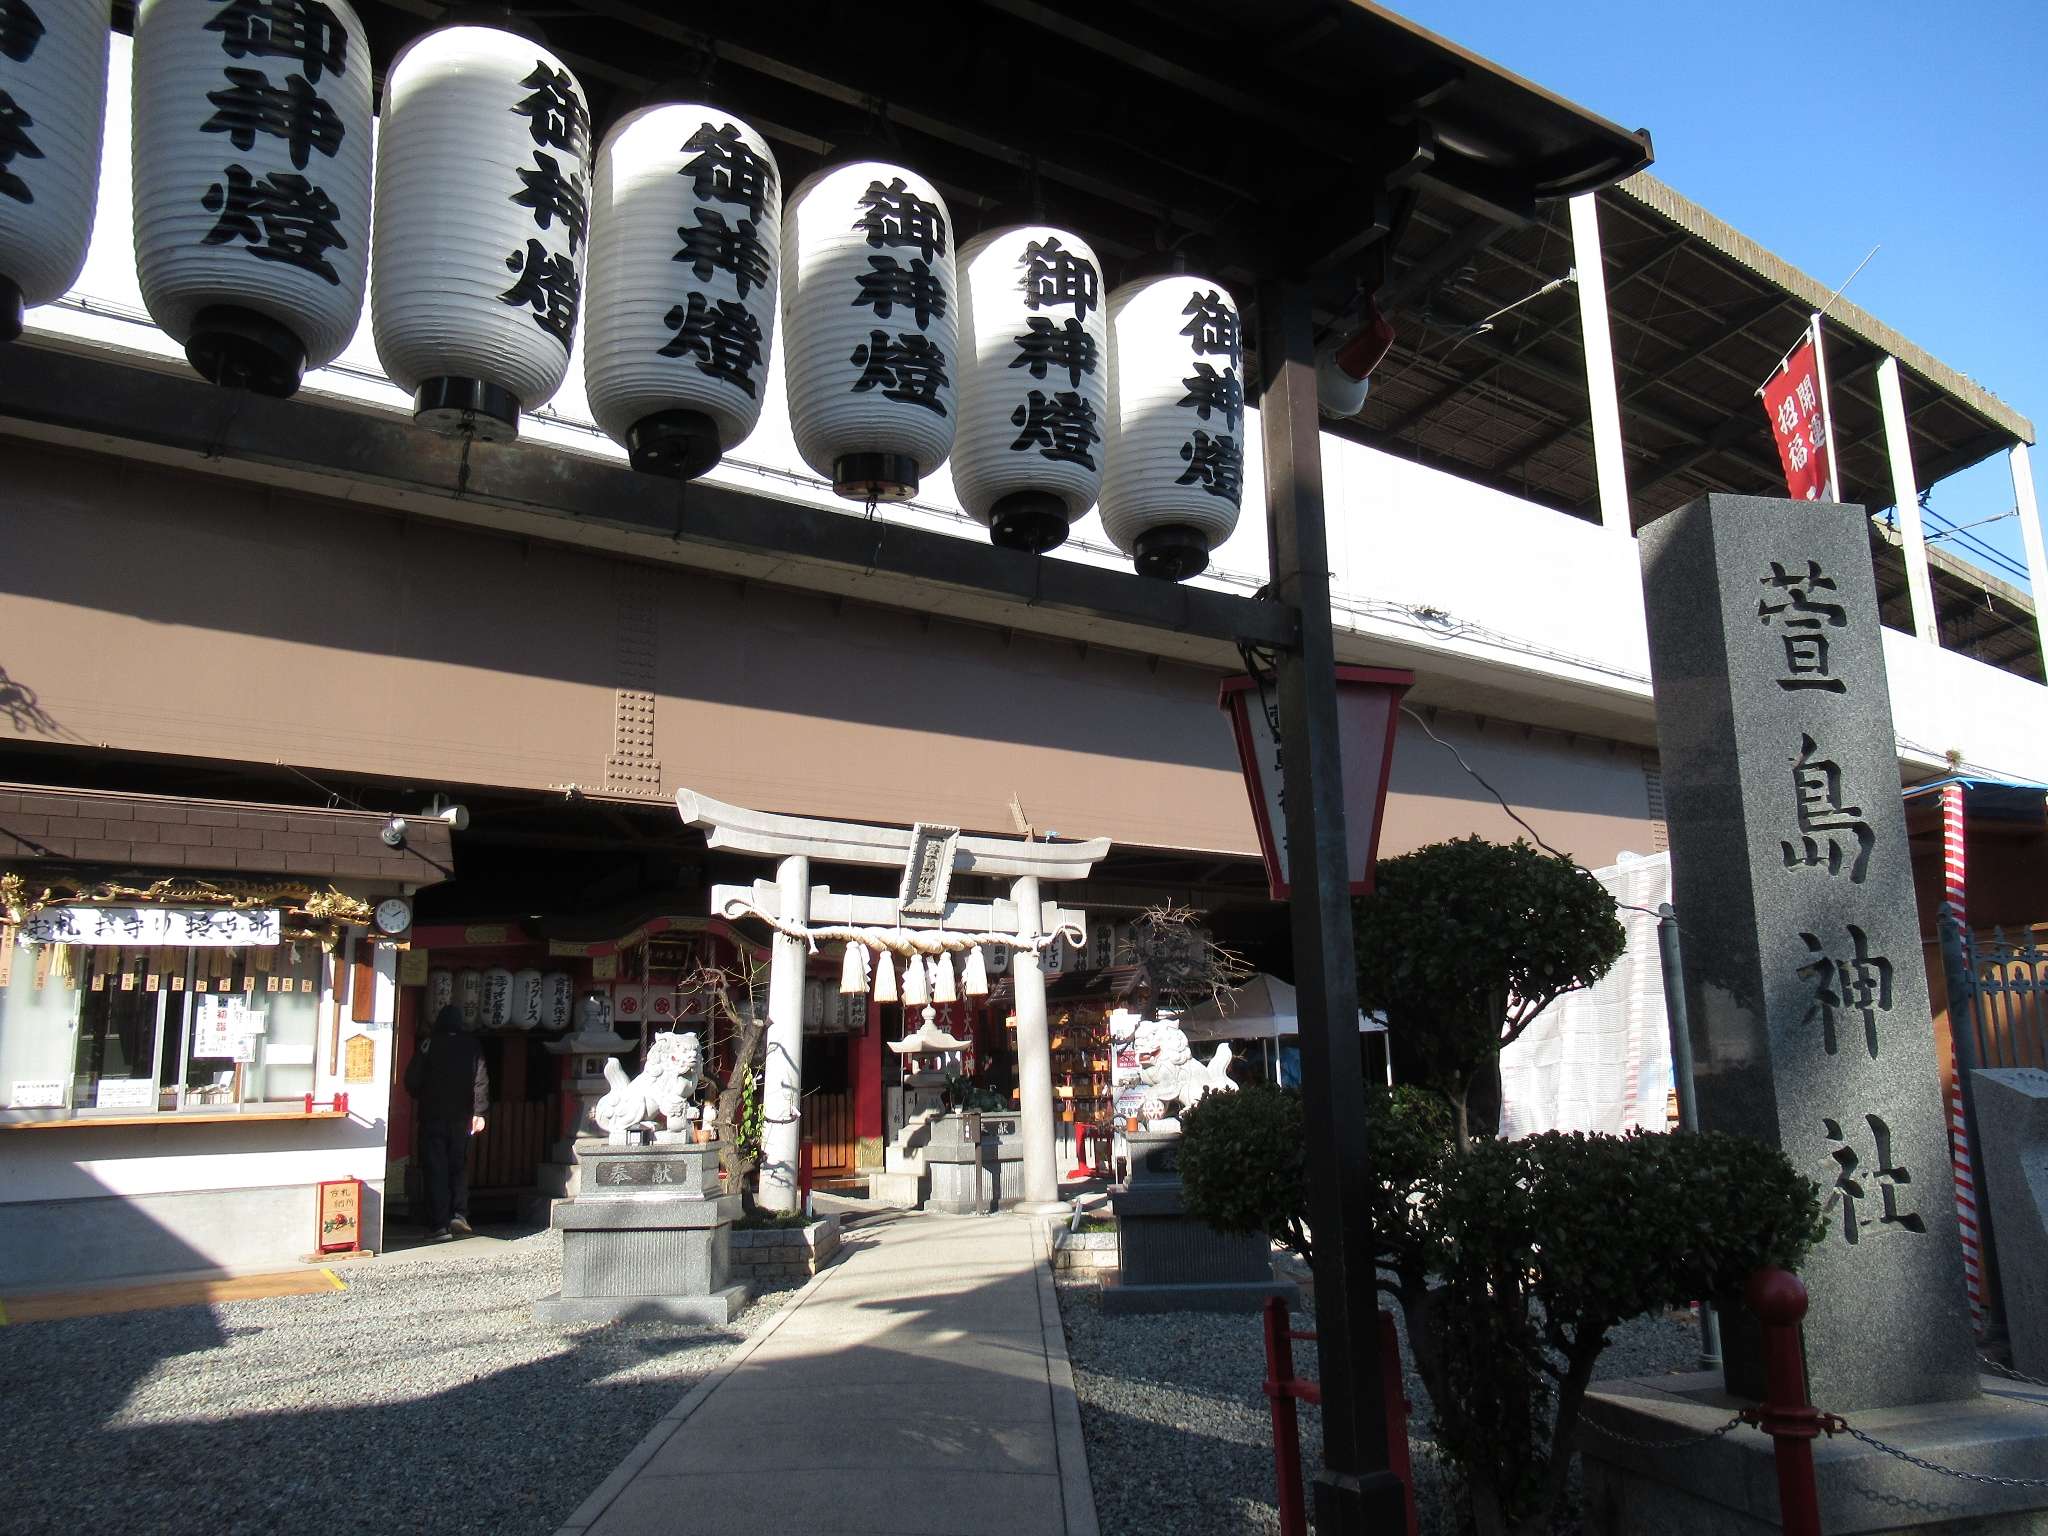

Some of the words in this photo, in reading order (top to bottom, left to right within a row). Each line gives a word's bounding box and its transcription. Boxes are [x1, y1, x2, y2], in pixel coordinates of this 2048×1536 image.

[656, 120, 777, 400] 御神燈
[849, 176, 951, 418] 御神燈
[1007, 235, 1102, 473] 御神燈
[1795, 373, 1826, 454] 開運
[1777, 395, 1808, 473] 招福
[28, 914, 81, 938] お札
[1757, 559, 1926, 1246] 萱島神社
[609, 1162, 673, 1184] 奉献
